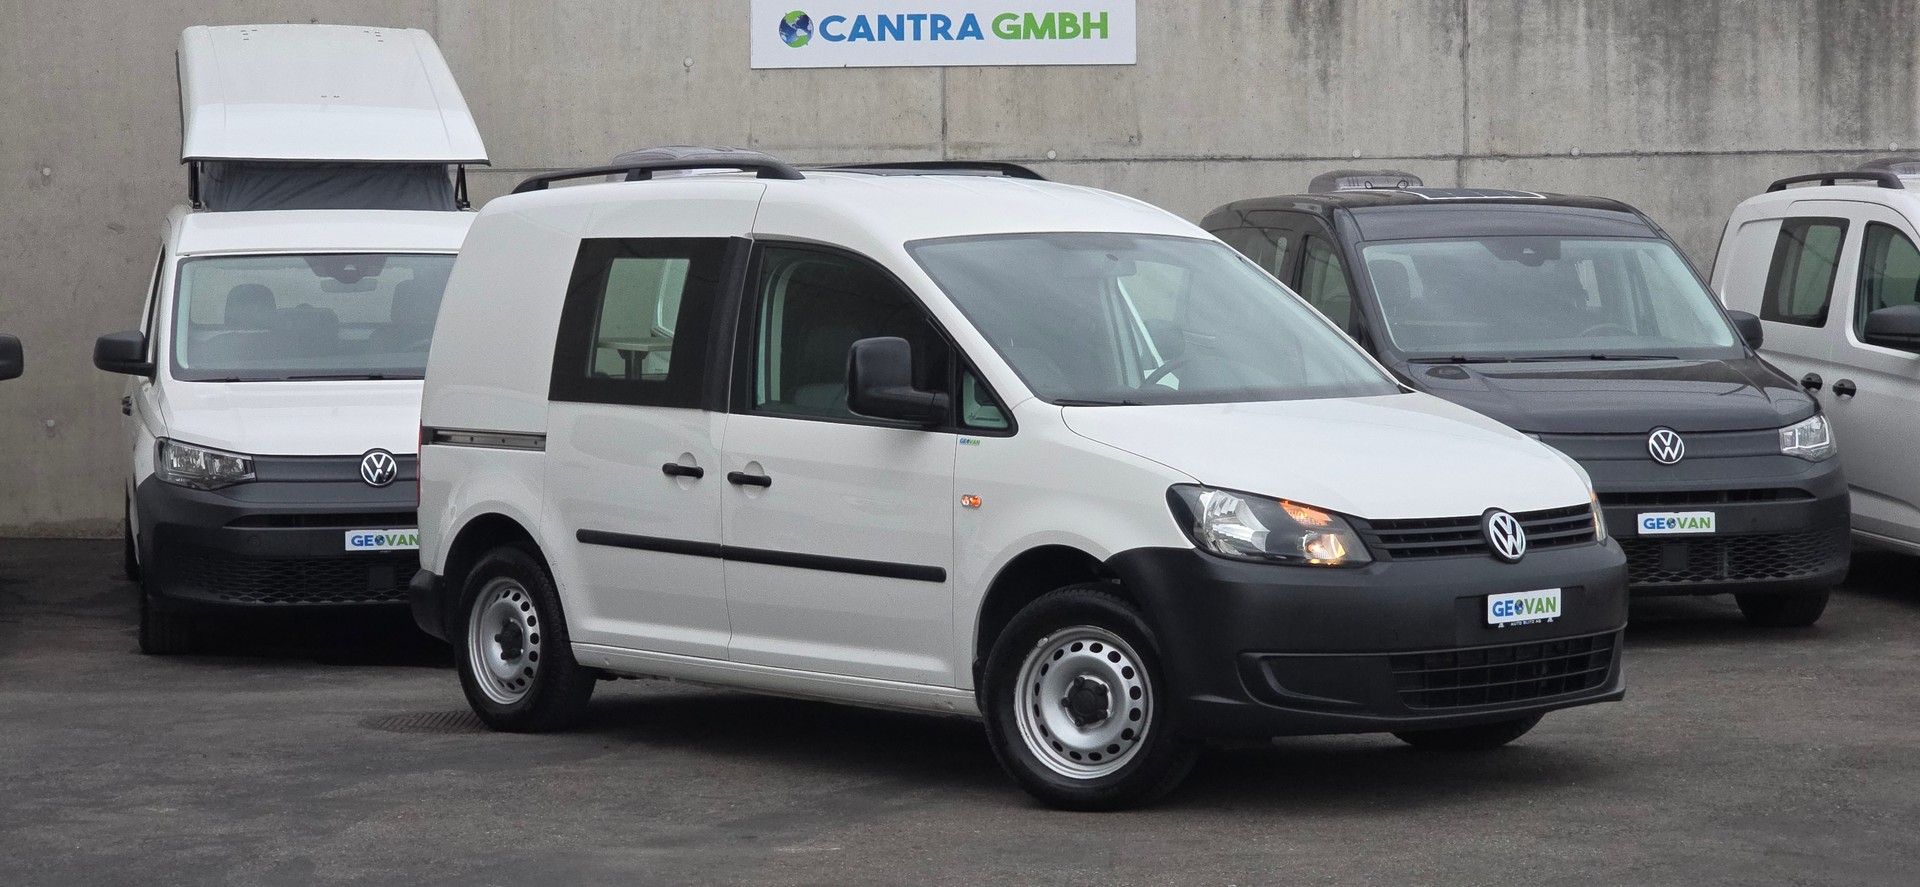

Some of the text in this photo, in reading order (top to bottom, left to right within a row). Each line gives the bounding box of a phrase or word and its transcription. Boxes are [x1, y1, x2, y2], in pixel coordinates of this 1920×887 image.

[818, 12, 1108, 42] CANTRA GMBH
[1643, 517, 1711, 530] GEOVAN
[351, 534, 419, 547] GEOVAN
[1492, 597, 1556, 617] GEOVAN
